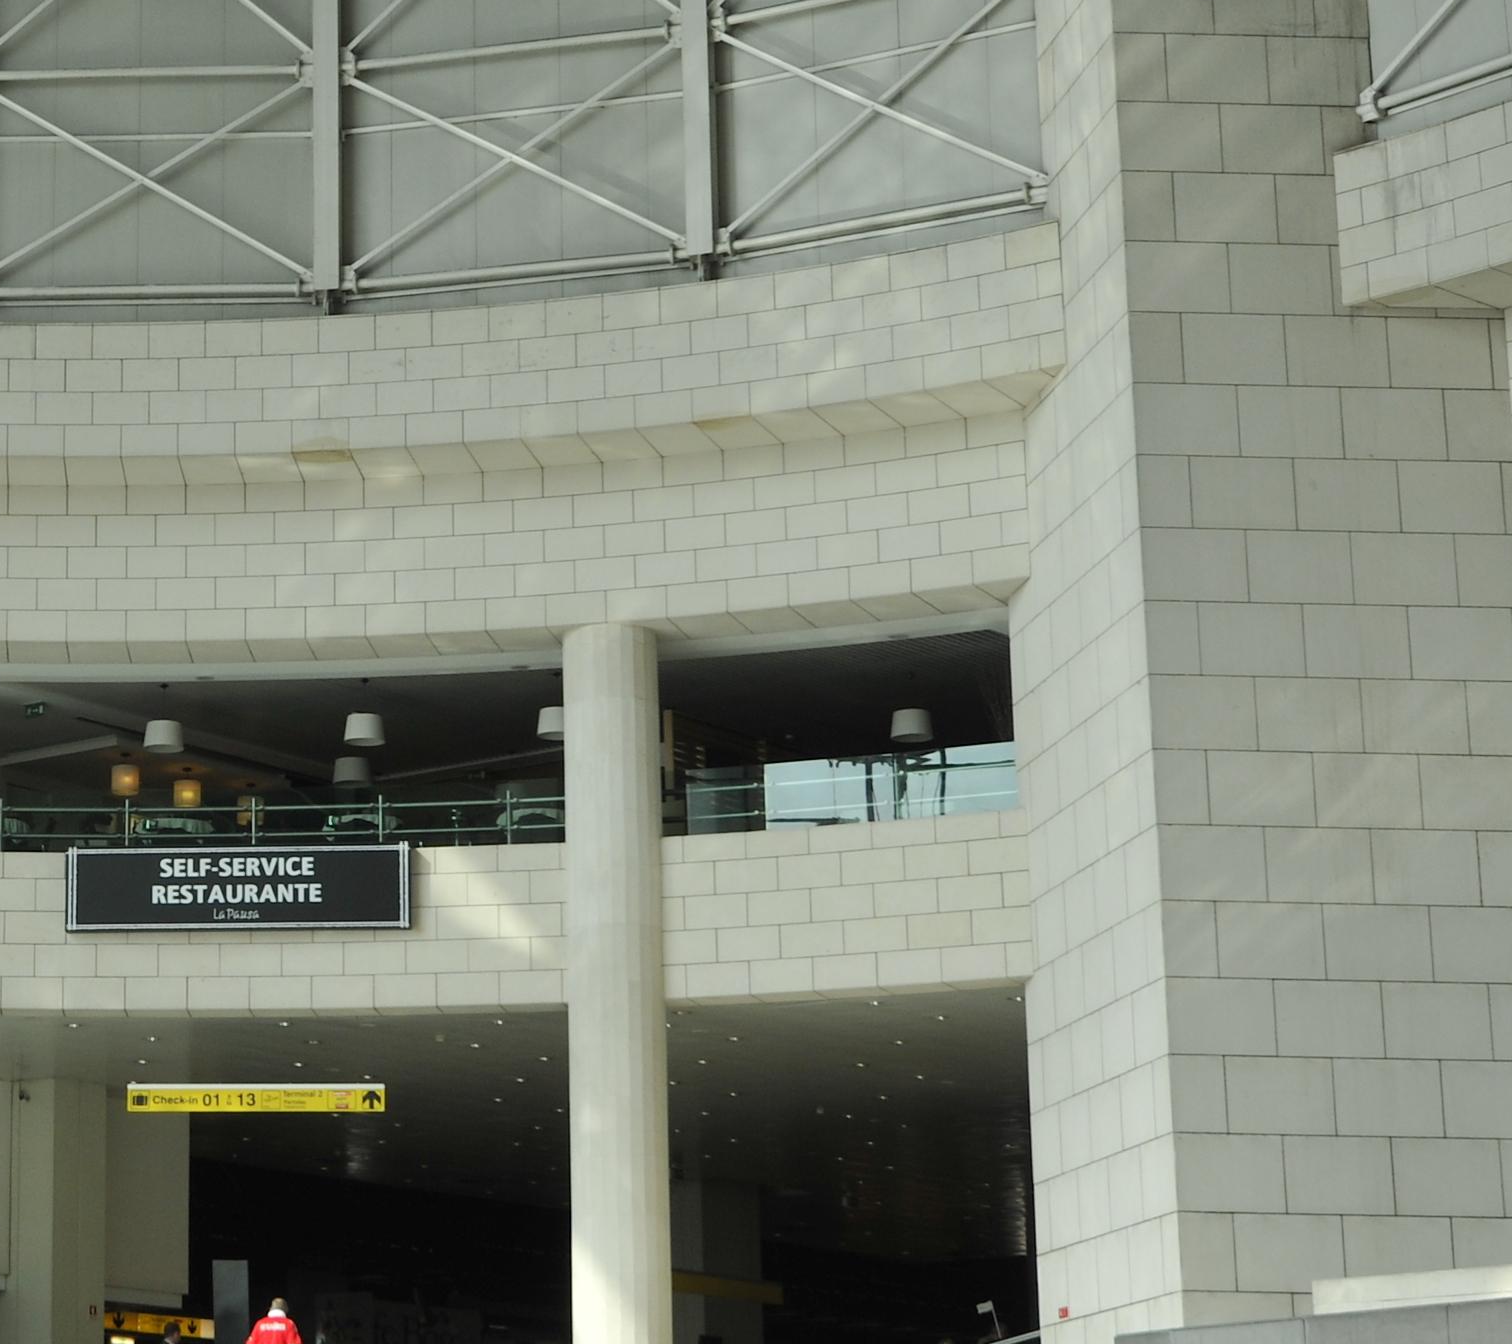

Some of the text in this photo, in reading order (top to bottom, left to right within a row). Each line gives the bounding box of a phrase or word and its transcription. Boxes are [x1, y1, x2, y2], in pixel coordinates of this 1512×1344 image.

[159, 856, 315, 878] SELF-SERVICE
[151, 883, 322, 905] RESTAURANTE
[213, 908, 260, 921] La Pausa
[152, 1093, 198, 1105] Check-in
[202, 1093, 221, 1107] 01
[237, 1093, 256, 1107] 13
